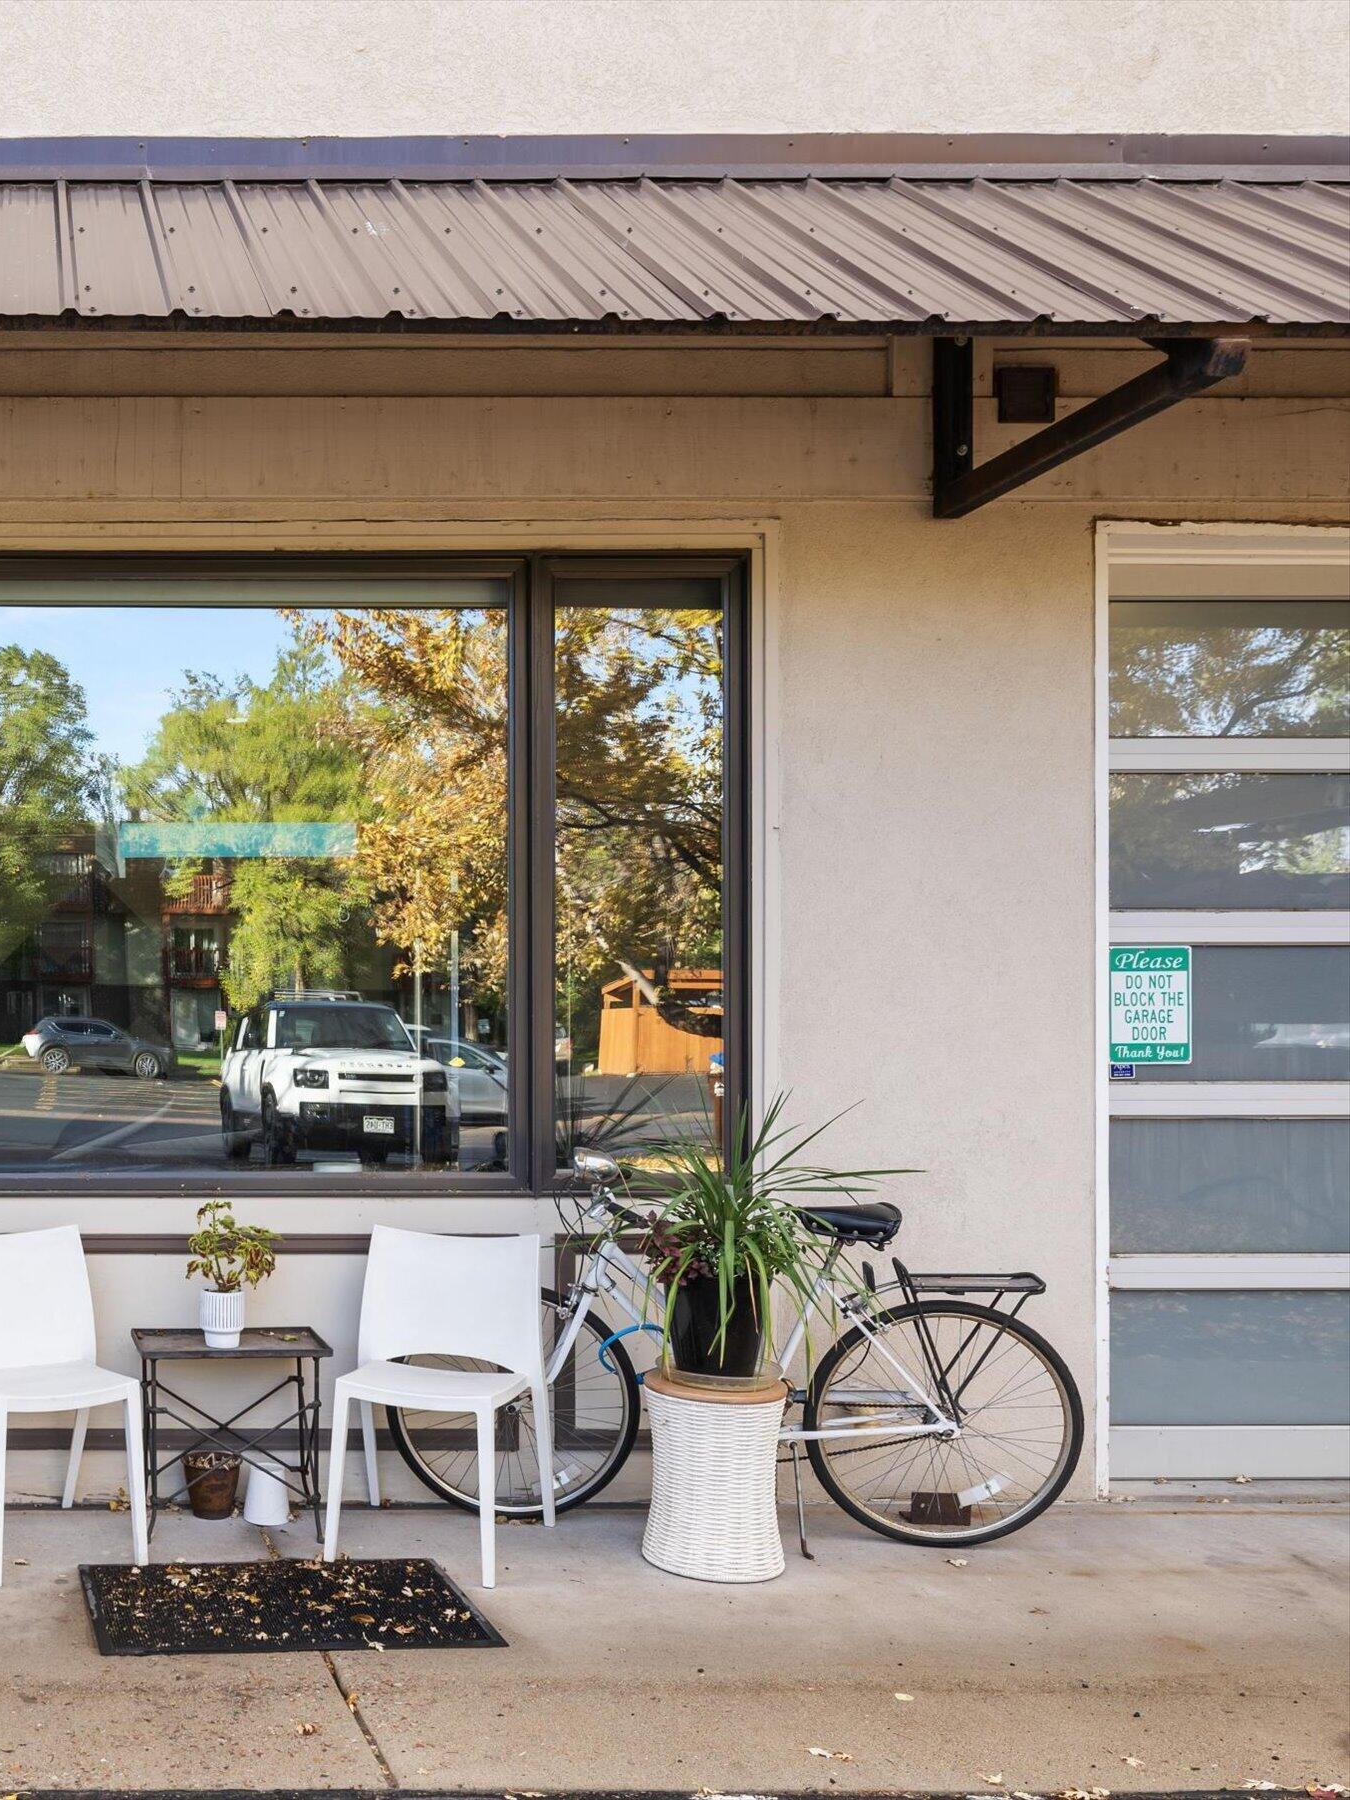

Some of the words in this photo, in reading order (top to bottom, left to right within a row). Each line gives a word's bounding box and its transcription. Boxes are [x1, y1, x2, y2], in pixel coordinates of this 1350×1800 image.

[1115, 951, 1183, 969] Please
[1125, 975, 1143, 989] DO
[1148, 975, 1173, 989] NOT
[1114, 992, 1155, 1006] BLOCK
[1161, 992, 1184, 1006] THE
[1124, 1009, 1174, 1024] GARAGE
[1132, 1026, 1167, 1041] DOOR
[1115, 1045, 1152, 1058] Thank
[1156, 1045, 1184, 1060] You!
